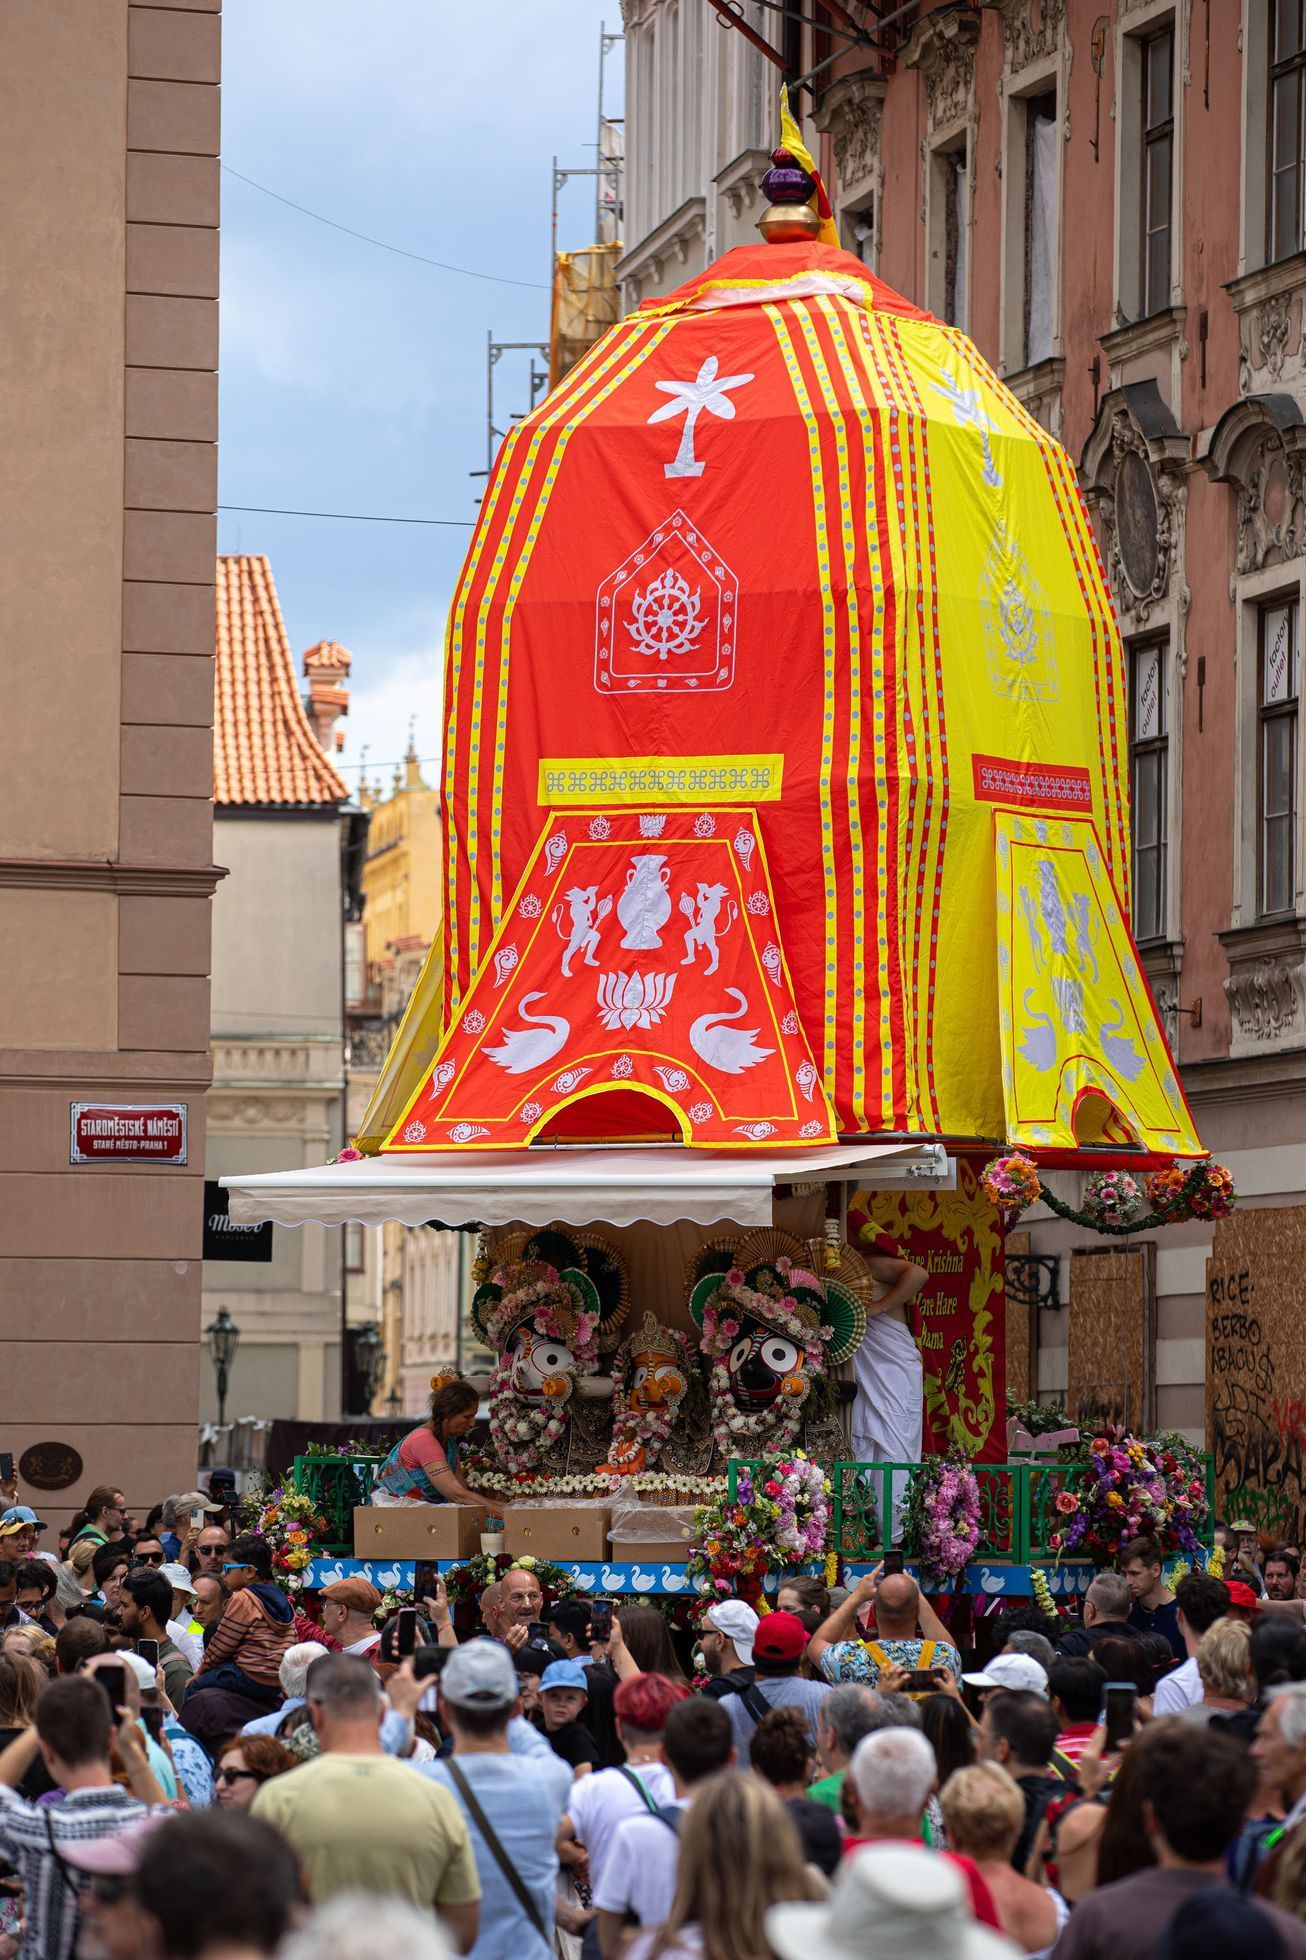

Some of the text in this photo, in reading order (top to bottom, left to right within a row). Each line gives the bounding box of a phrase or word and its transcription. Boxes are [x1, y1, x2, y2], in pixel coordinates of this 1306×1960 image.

[1271, 651, 1286, 698] outlet
[1142, 690, 1157, 735] outlet
[81, 1116, 179, 1136] STAROMĚSTSKÉ NÁMĚSTÍ
[93, 1138, 115, 1149] STARÉ
[927, 1249, 964, 1273] Krishna
[936, 1291, 958, 1316] Hare
